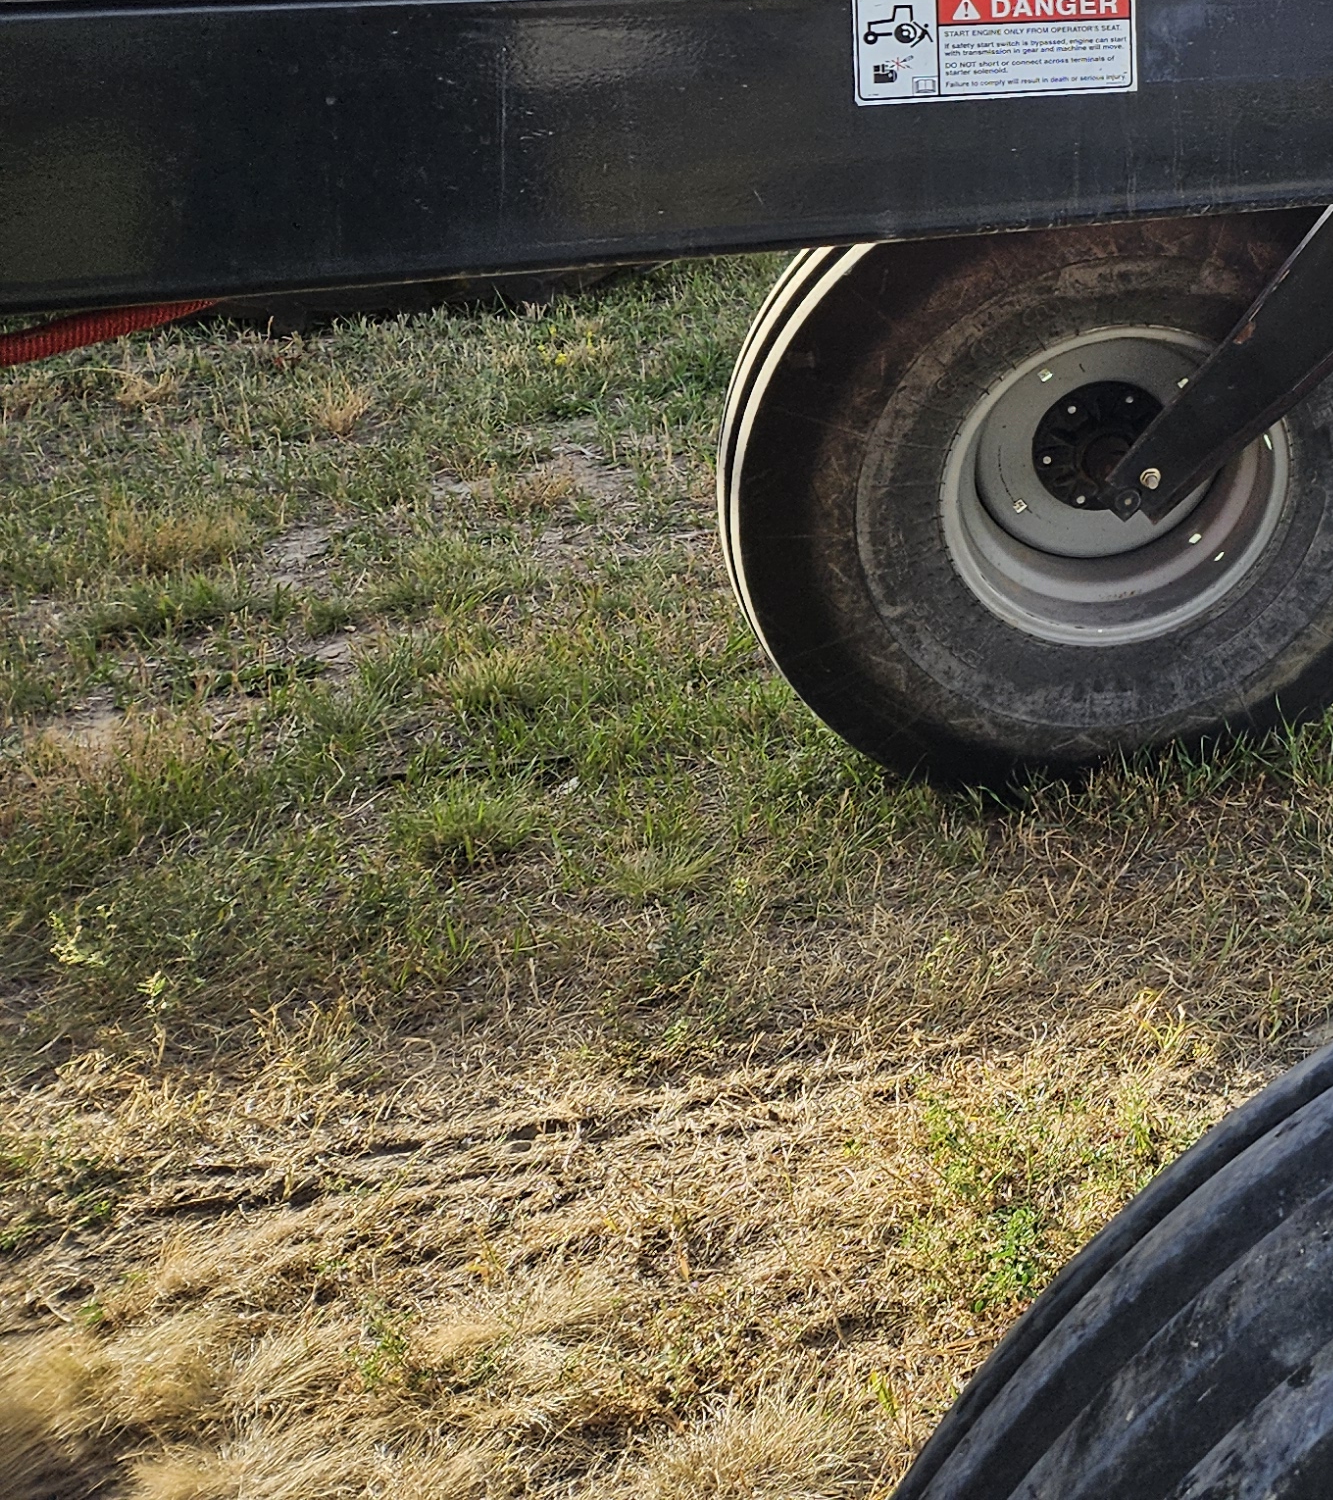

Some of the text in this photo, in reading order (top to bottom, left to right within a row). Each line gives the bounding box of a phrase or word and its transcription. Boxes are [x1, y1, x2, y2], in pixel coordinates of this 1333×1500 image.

[1051, 25, 1099, 33] OPERATOR'S
[952, 42, 974, 50] safety
[963, 48, 1011, 56] transmission
